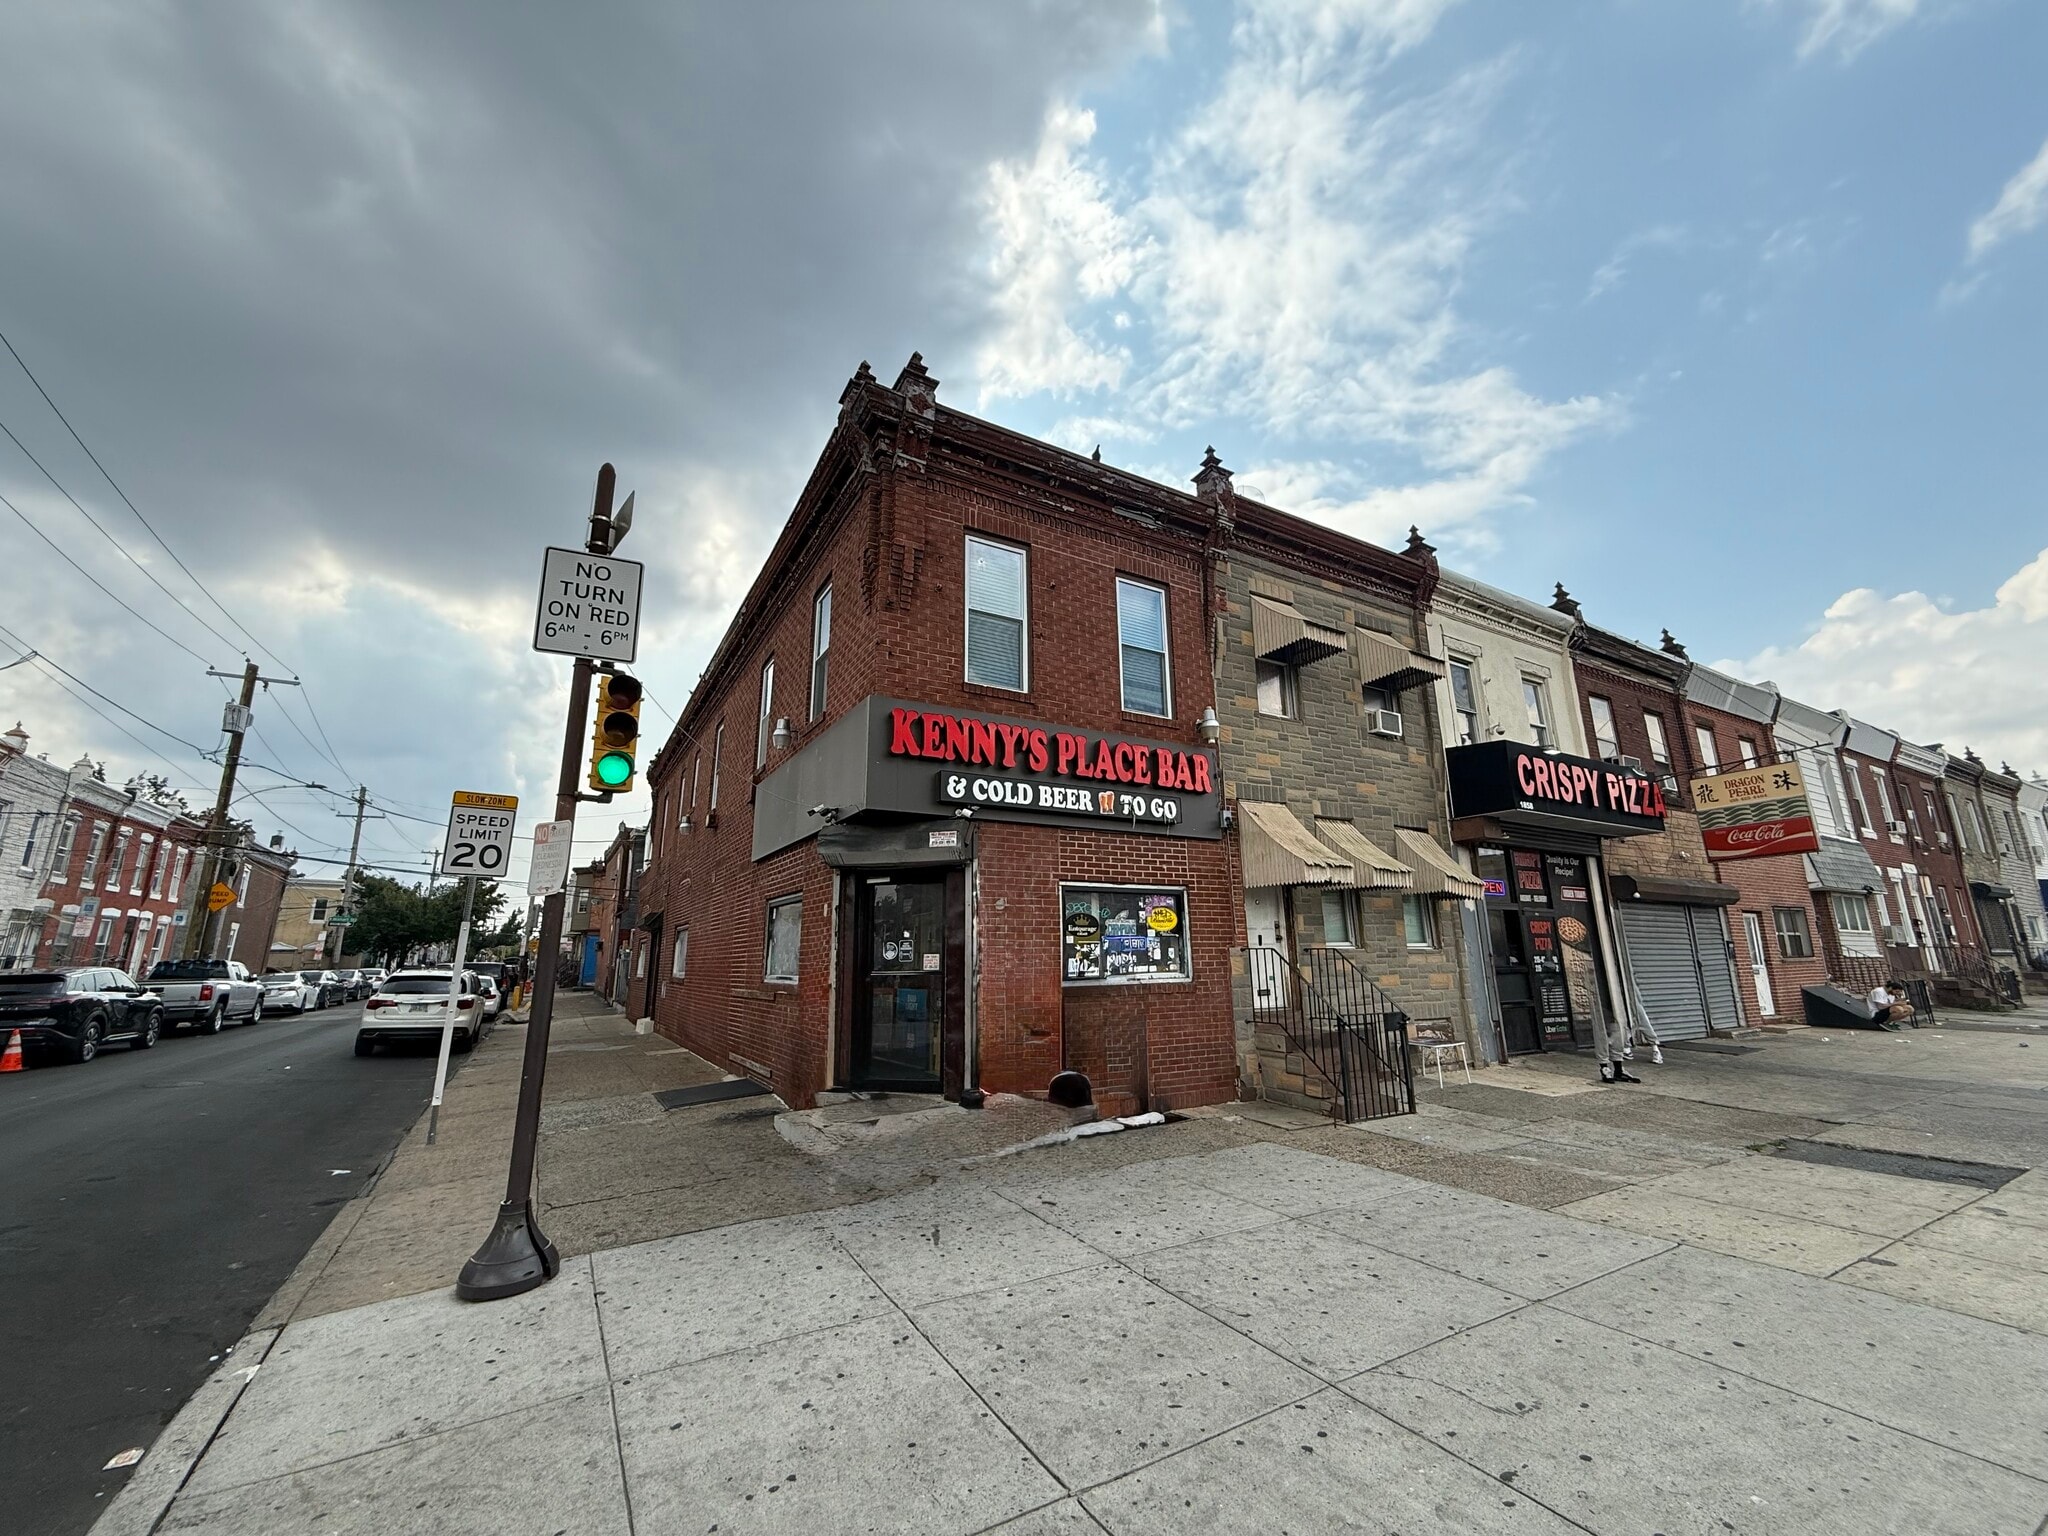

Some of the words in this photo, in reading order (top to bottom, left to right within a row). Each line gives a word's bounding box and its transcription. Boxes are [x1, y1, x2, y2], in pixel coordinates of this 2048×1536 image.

[576, 562, 611, 581] NO
[560, 580, 624, 605] TURN
[548, 600, 580, 619] ON
[590, 606, 630, 626] RED
[545, 622, 575, 637] 6AM
[601, 630, 629, 645] 6PM
[890, 707, 1049, 773] KENNY'S
[1055, 733, 1151, 785] PLACE
[1156, 748, 1213, 794] BAR
[1517, 754, 1600, 807] CRISPY
[1605, 772, 1667, 818] PIZZA
[1724, 774, 1765, 790] DRAGON
[466, 795, 486, 804] SLOW
[488, 796, 507, 806] ZONE
[947, 775, 966, 799] &
[972, 778, 1033, 805] COLD
[1038, 785, 1094, 812] BEER
[1120, 794, 1146, 817] TO
[1151, 798, 1177, 819] GO
[1728, 786, 1765, 799] PEARL
[456, 814, 509, 828] SPEED
[459, 828, 502, 840] LIMIT
[535, 826, 549, 842] NO
[1727, 823, 1785, 845] Coca-Cola
[450, 842, 502, 869] 20
[1485, 882, 1503, 893] PEN
